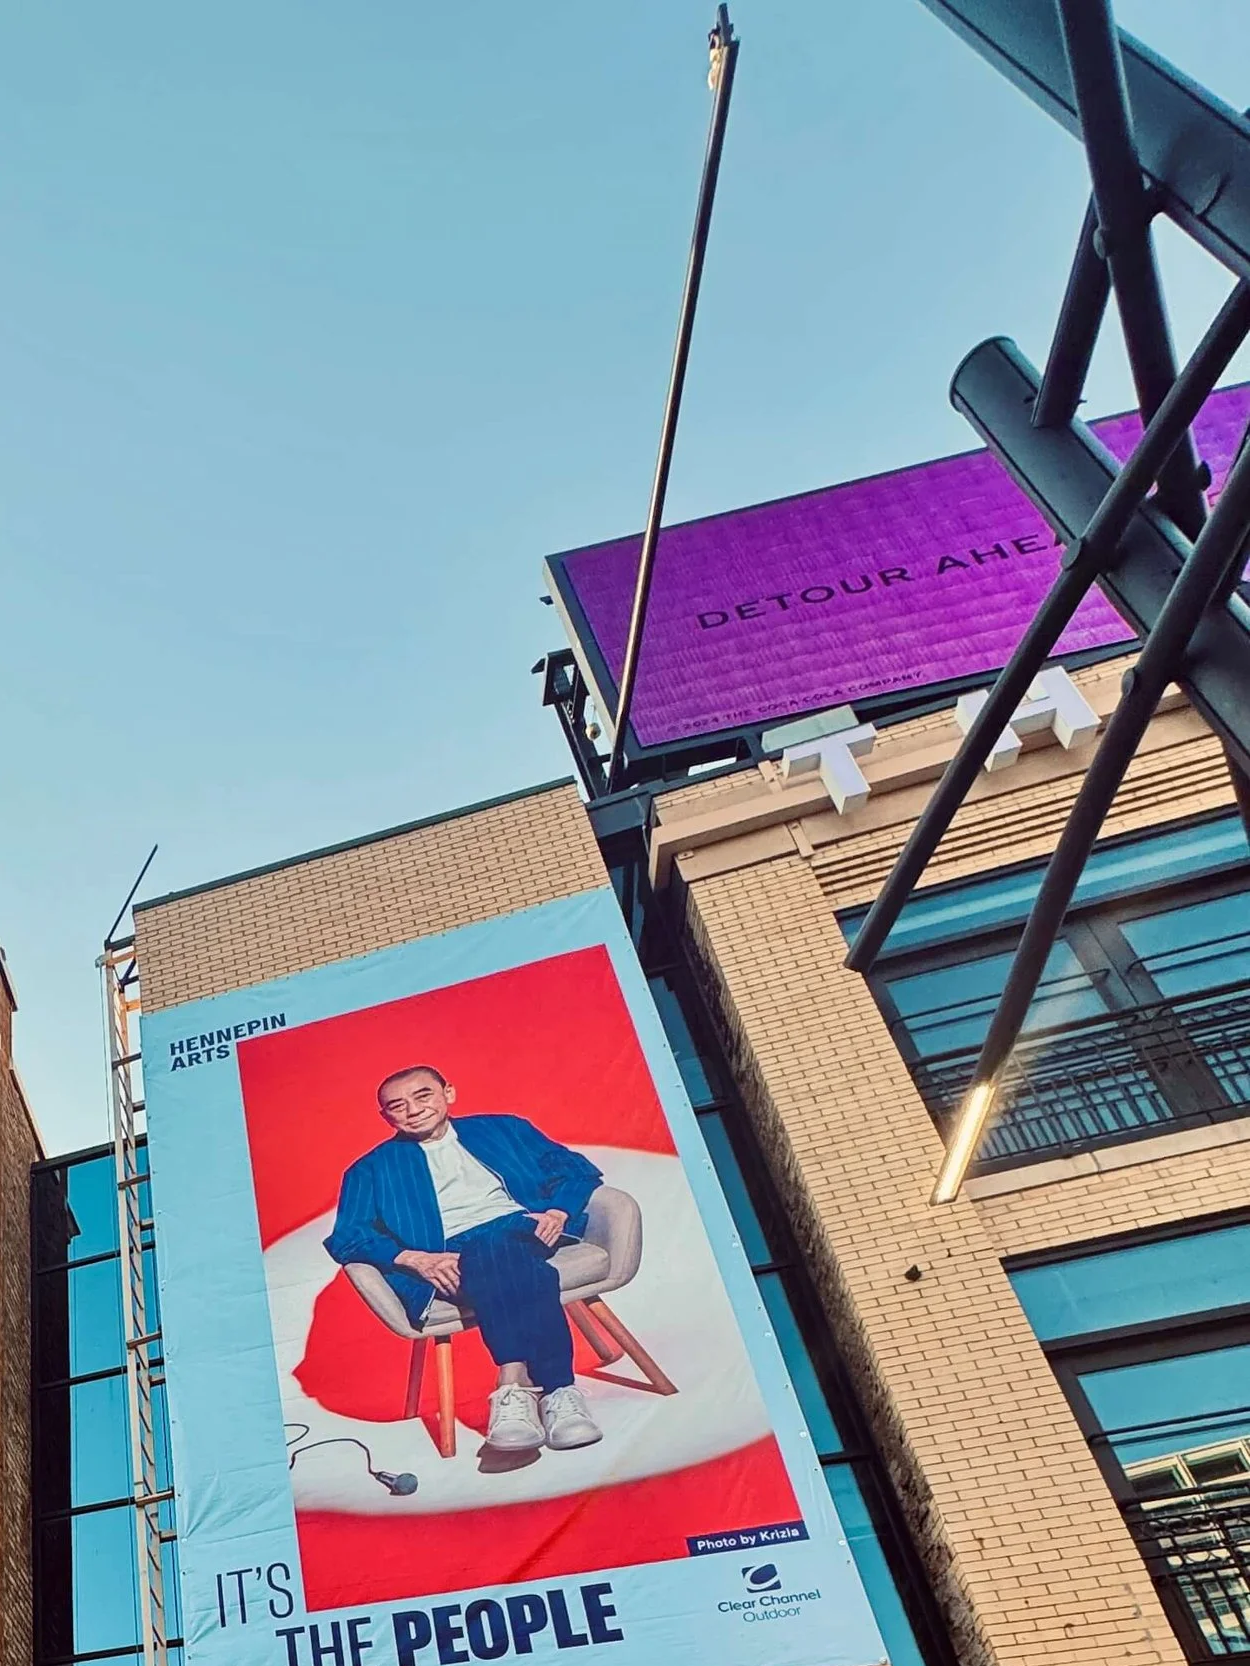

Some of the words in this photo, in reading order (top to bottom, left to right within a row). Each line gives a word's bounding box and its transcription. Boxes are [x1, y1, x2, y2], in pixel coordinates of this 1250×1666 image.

[697, 567, 914, 630] DETOUR
[936, 534, 1063, 575] AHE
[723, 709, 752, 722] THE
[758, 700, 799, 715] COCA
[803, 689, 842, 703] COLA
[848, 670, 922, 693] COMPANY
[170, 1013, 286, 1056] HENNEPIN
[171, 1044, 230, 1072] ARTS
[697, 1536, 736, 1550] Photo
[740, 1533, 756, 1545] by
[216, 1562, 293, 1627] IT'S
[718, 1600, 756, 1612] Clear
[759, 1589, 822, 1606] Channel
[743, 1606, 801, 1623] Outdoor
